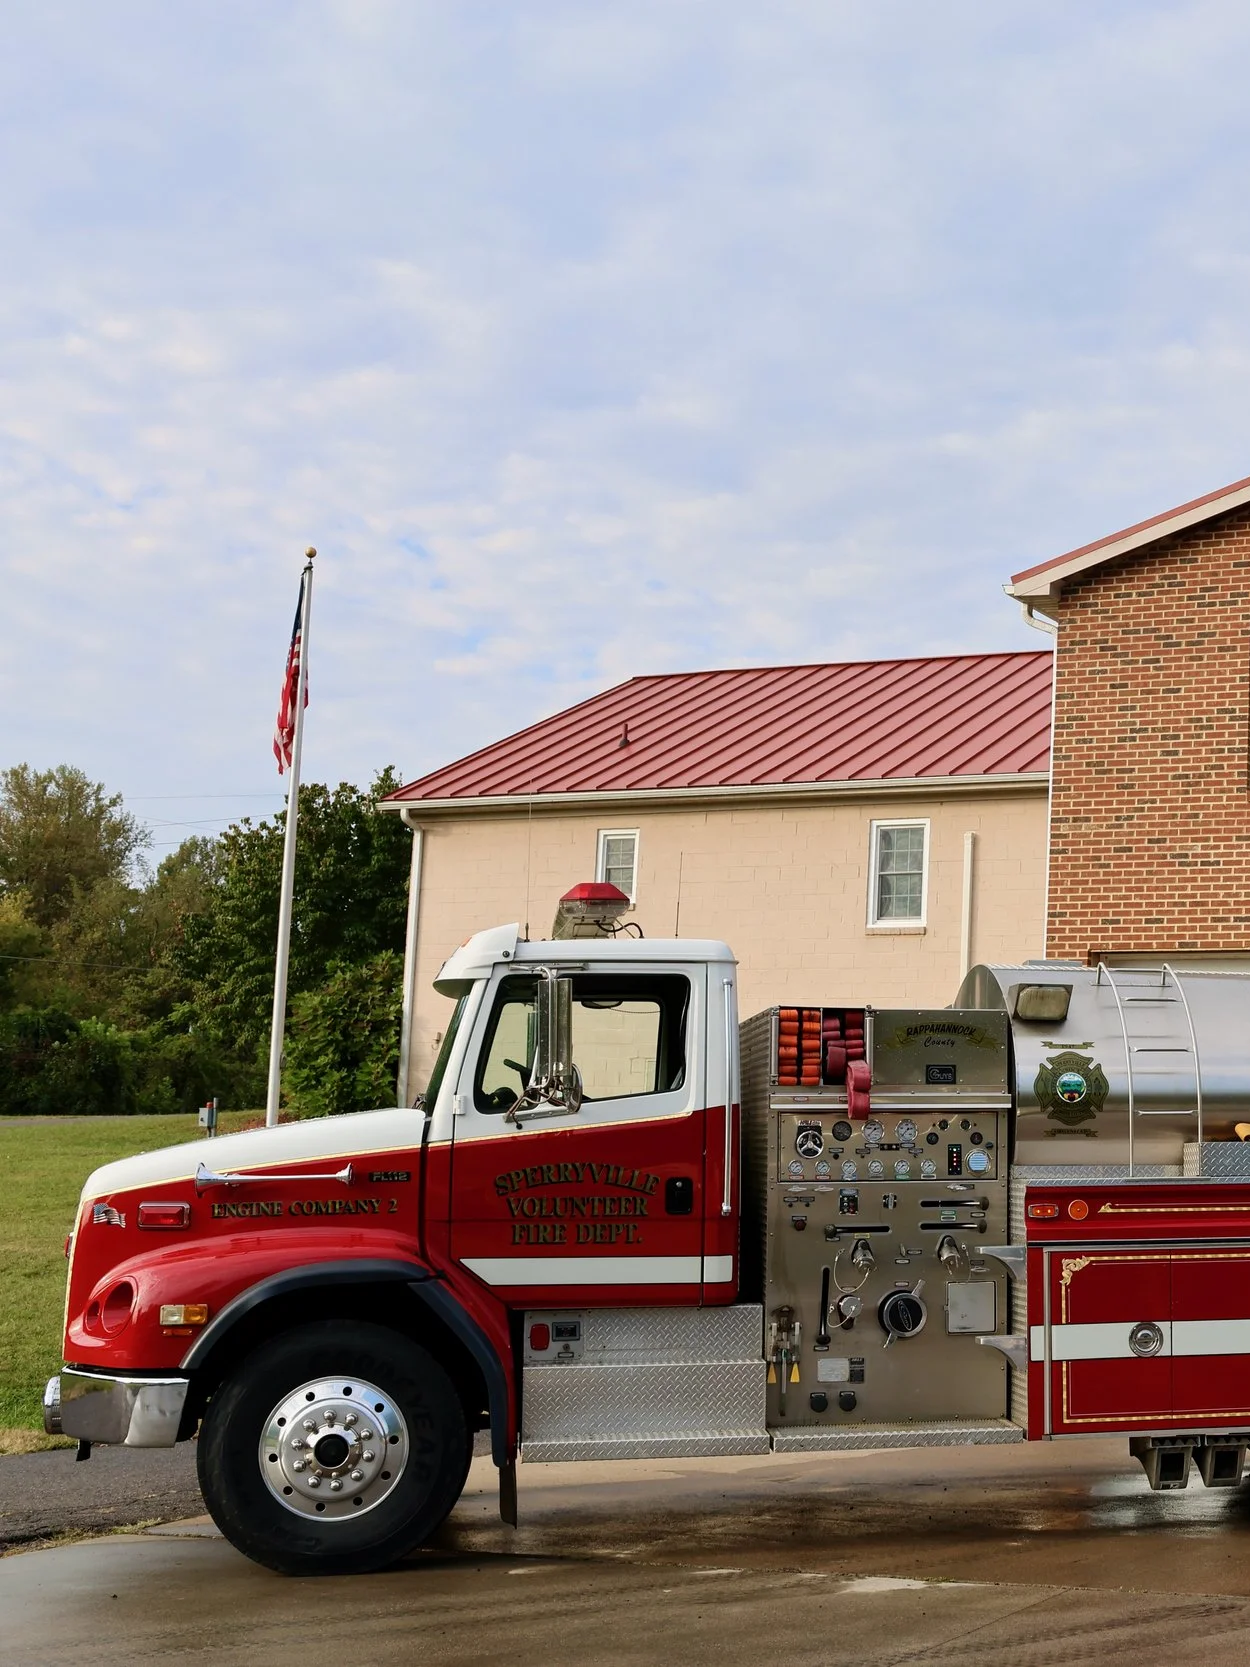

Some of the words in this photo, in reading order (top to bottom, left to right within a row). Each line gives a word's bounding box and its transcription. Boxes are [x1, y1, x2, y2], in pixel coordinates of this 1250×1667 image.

[906, 1024, 976, 1037] RAPPAHANNOCK
[924, 1036, 955, 1047] County
[494, 1162, 660, 1196] SPERRYVILLE
[211, 1202, 283, 1218] ENGINE
[288, 1199, 382, 1217] COMPANY
[387, 1199, 398, 1213] 2
[506, 1196, 648, 1218] VOLUNTEER
[511, 1223, 567, 1245] FIRE
[575, 1223, 643, 1245] DEPT.
